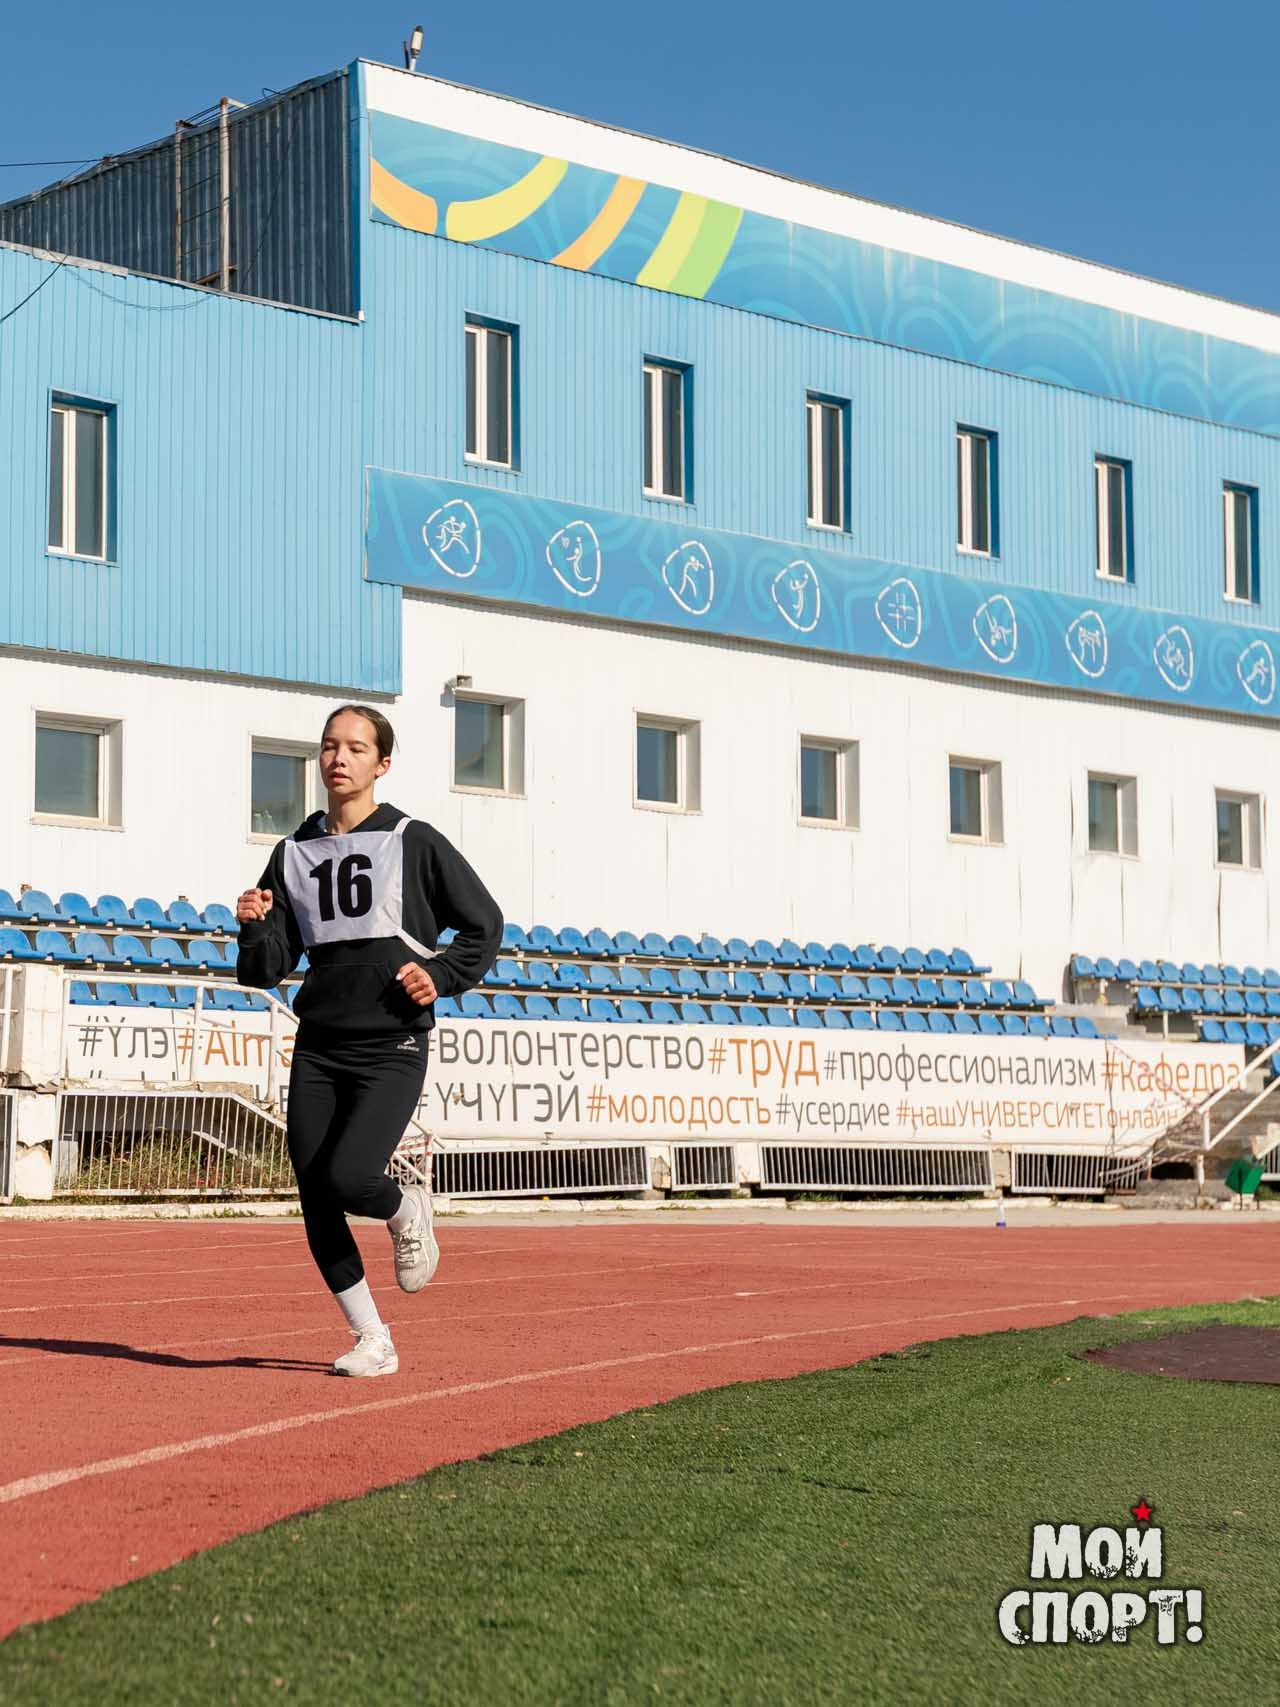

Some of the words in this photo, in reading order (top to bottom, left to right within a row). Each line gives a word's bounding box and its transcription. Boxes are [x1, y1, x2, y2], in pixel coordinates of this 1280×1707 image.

[309, 853, 373, 922] 16
[708, 1037, 820, 1089] #труд
[823, 1043, 1096, 1092] #профессионализм
[586, 1083, 772, 1131] #молодость
[775, 1093, 890, 1133] #усердие
